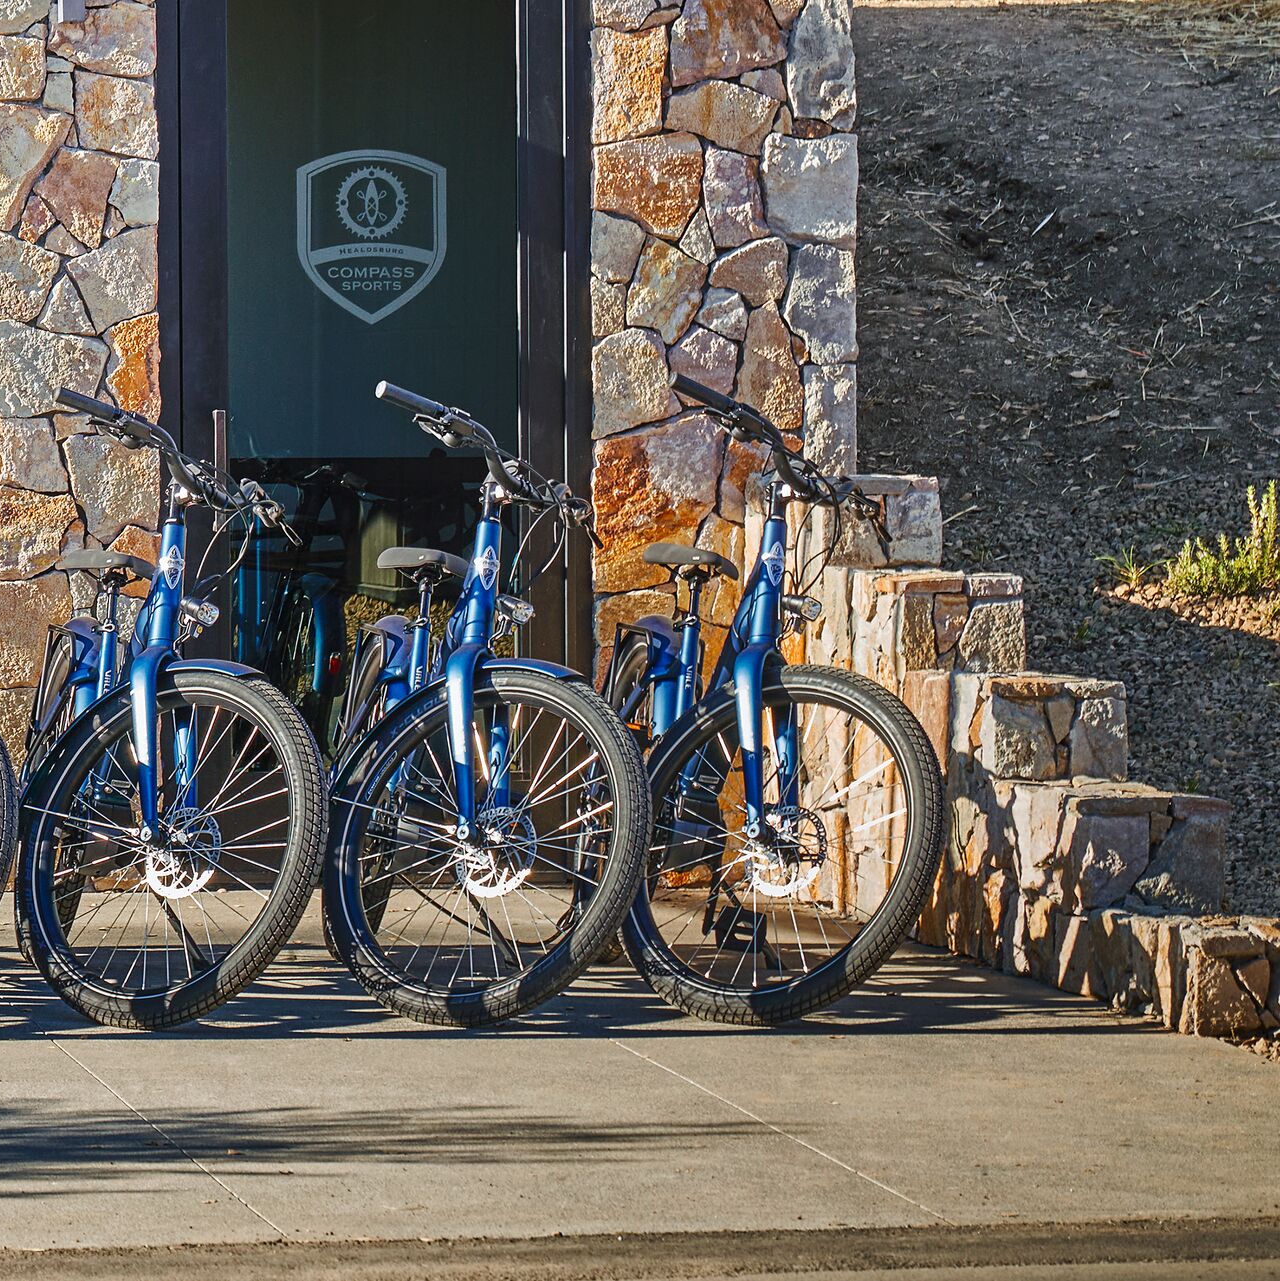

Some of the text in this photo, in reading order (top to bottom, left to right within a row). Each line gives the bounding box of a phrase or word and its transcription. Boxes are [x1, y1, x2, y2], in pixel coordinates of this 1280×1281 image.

[339, 246, 404, 255] HEALDSBURG
[327, 267, 415, 279] COMPASS
[342, 281, 402, 291] SPORTS
